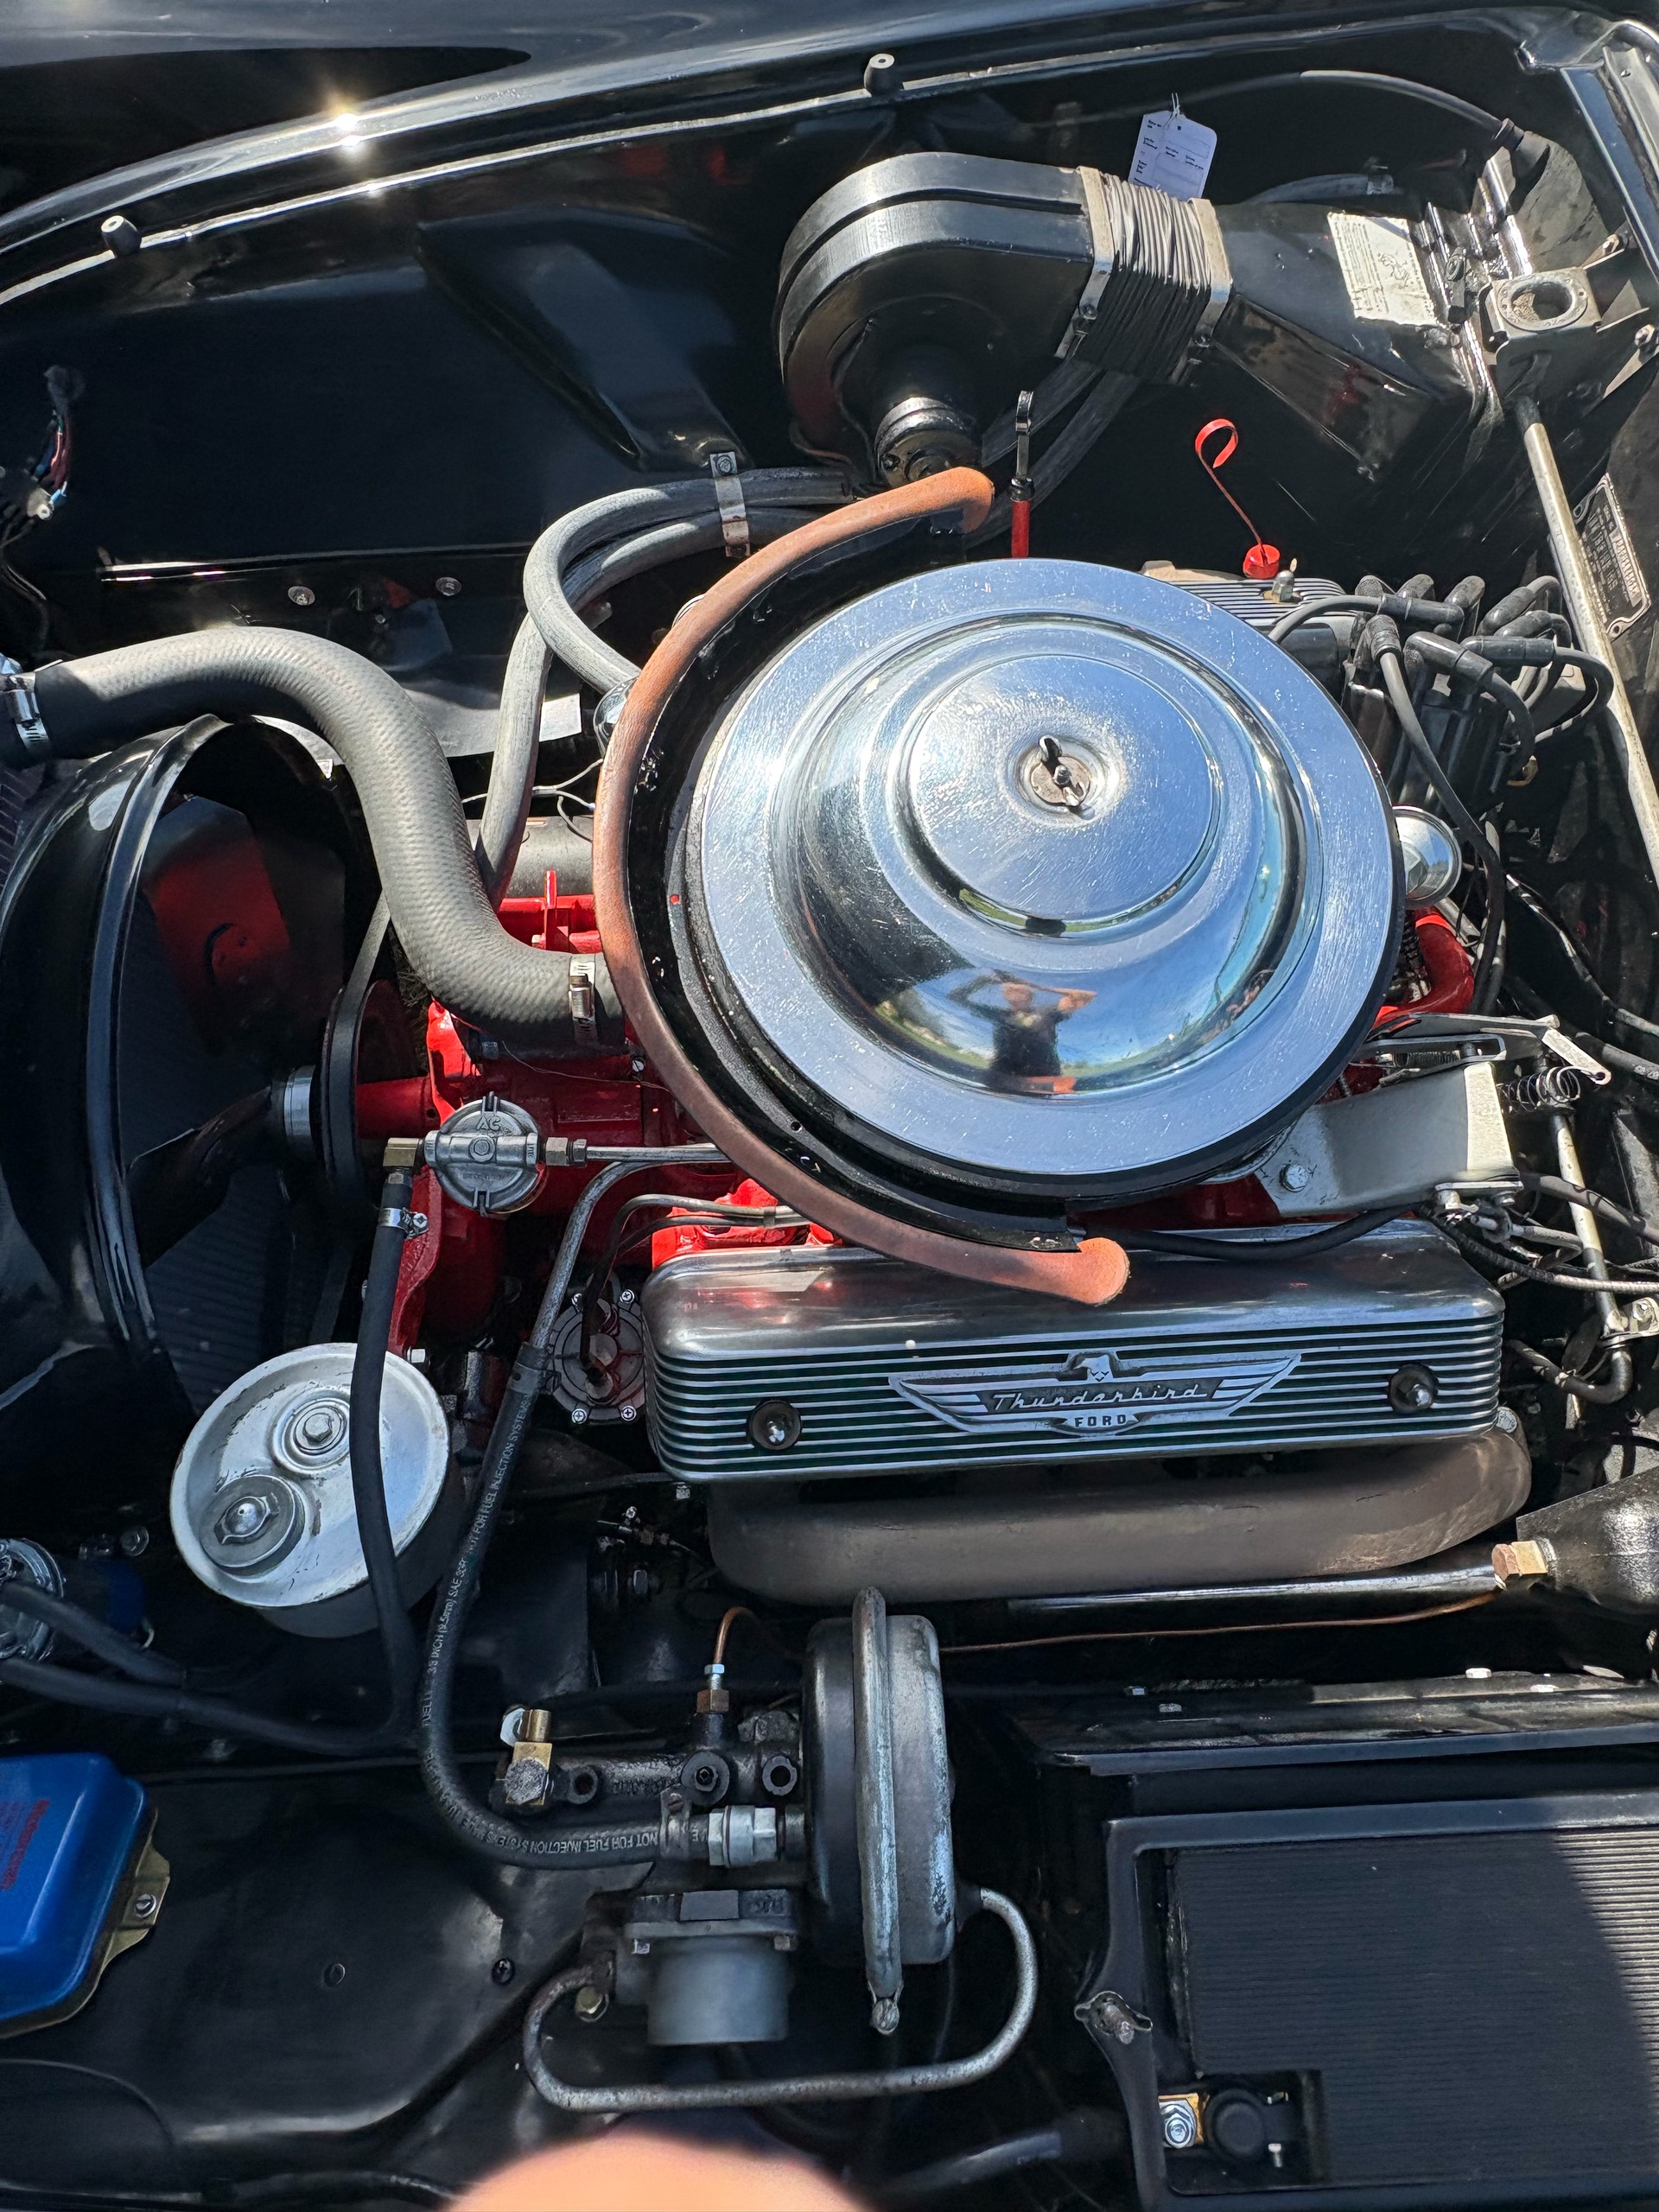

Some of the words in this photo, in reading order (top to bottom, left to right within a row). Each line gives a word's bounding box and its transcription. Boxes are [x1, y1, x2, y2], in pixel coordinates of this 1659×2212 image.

[992, 1383, 1208, 1412] Thunderbird
[1074, 1414, 1128, 1427] FORD
[446, 1576, 463, 1599] SAE
[470, 1511, 488, 1535] FOR
[479, 1488, 498, 1515] FUEL
[490, 1442, 514, 1490] INJECTION
[529, 1839, 582, 1855] INJECTION
[583, 1836, 608, 1853] FUEL
[610, 1834, 632, 1850] FOR
[636, 1831, 658, 1848] NOT
